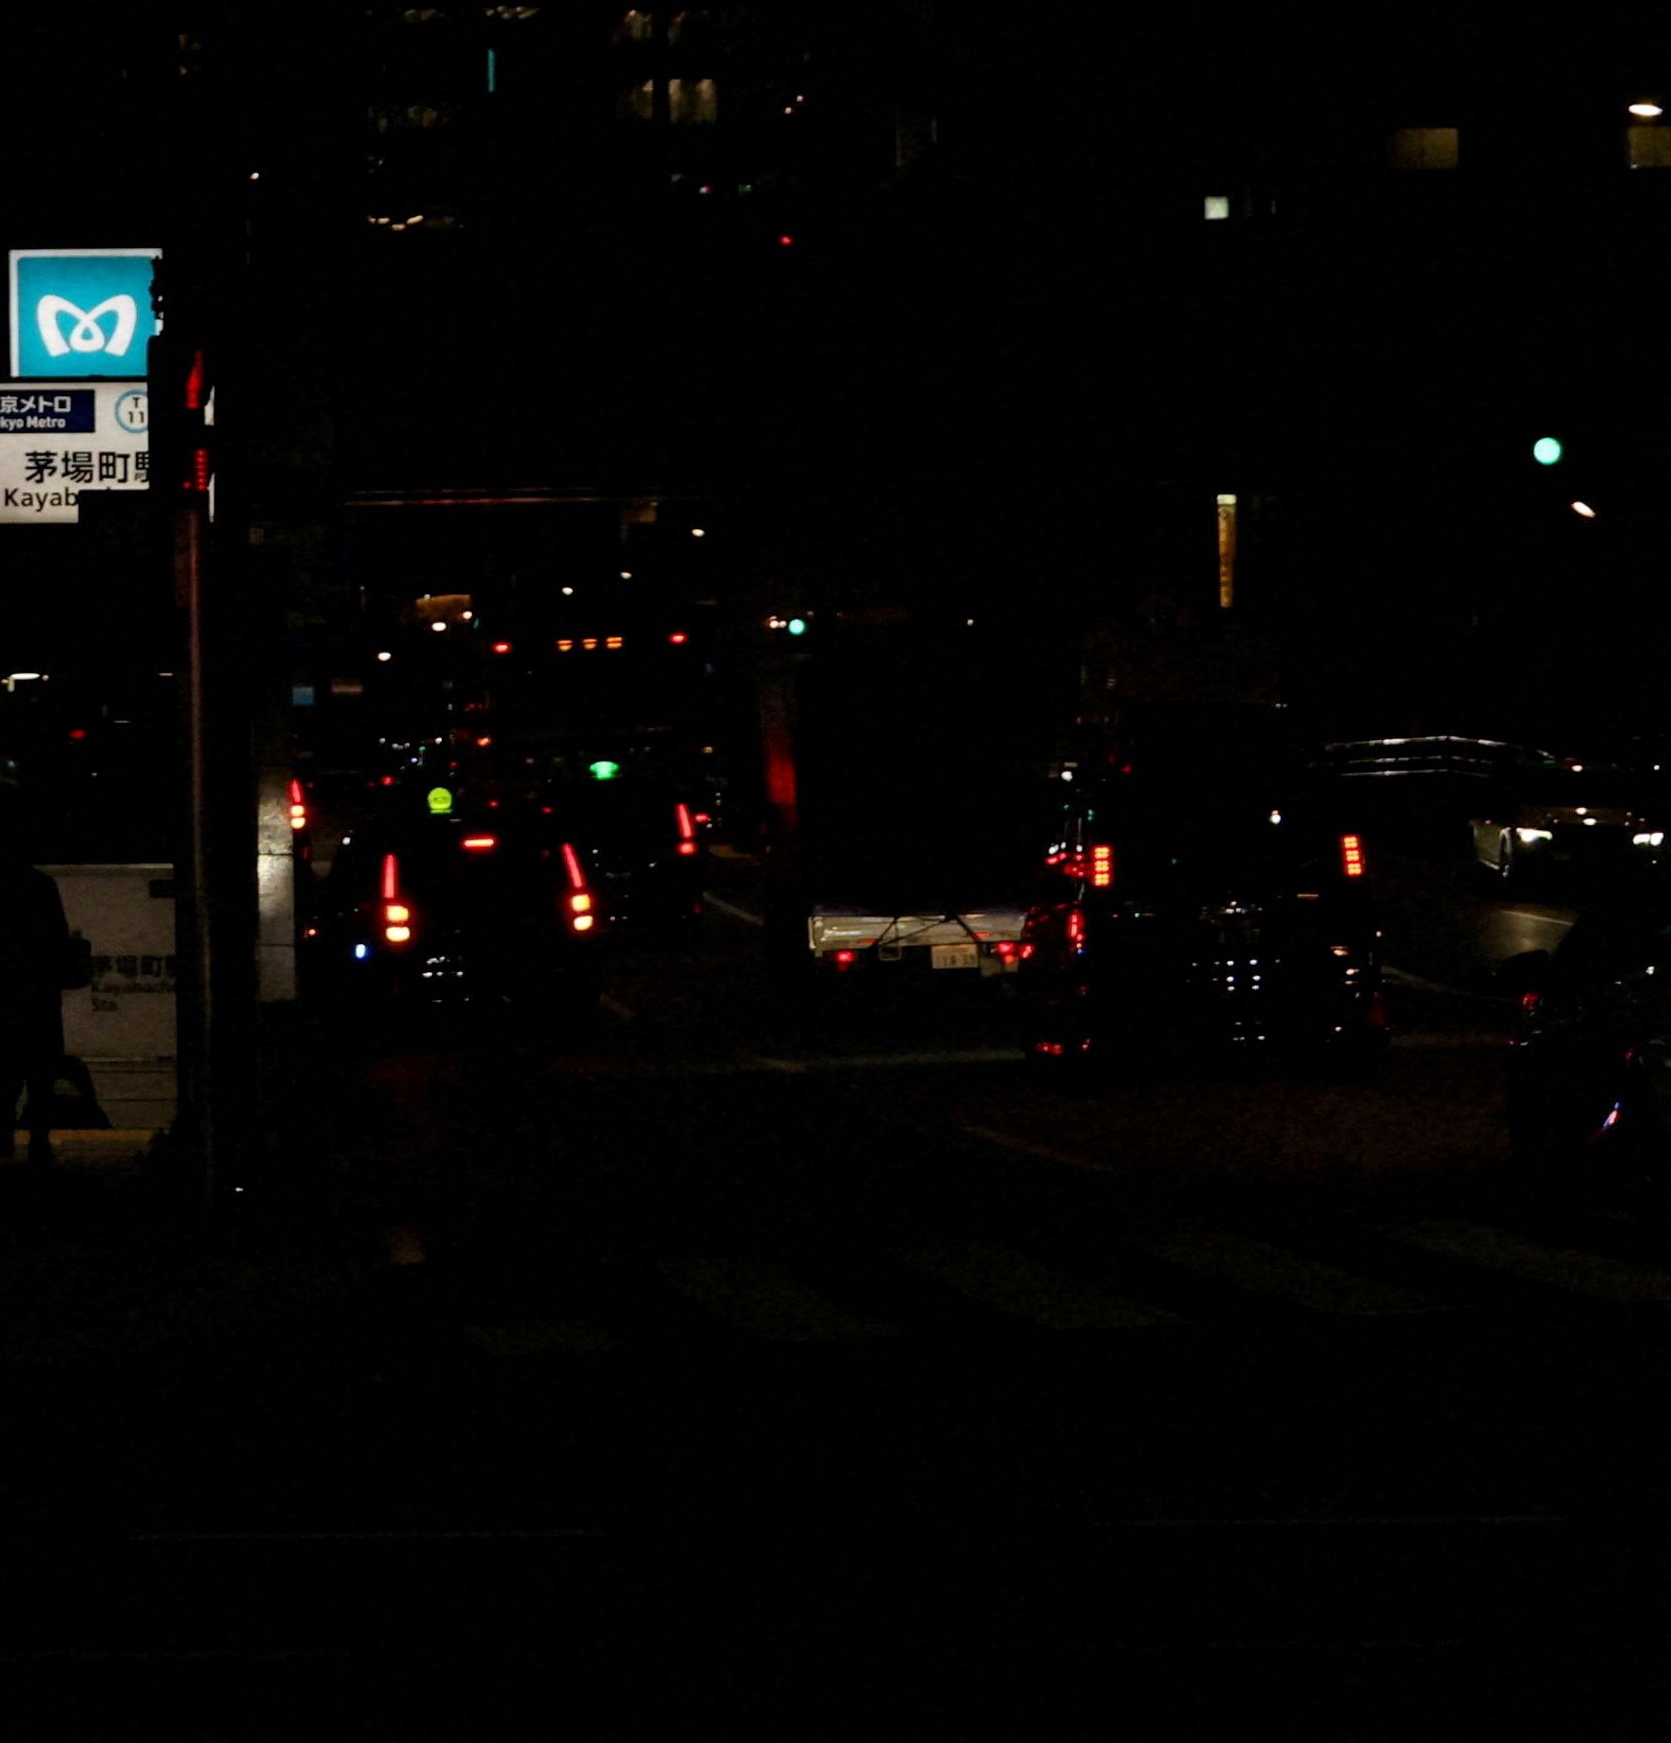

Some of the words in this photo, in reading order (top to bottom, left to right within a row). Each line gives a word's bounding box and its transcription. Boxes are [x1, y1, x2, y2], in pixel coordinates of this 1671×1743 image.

[132, 397, 141, 408] T
[26, 416, 66, 429] Metro
[128, 411, 145, 424] 11
